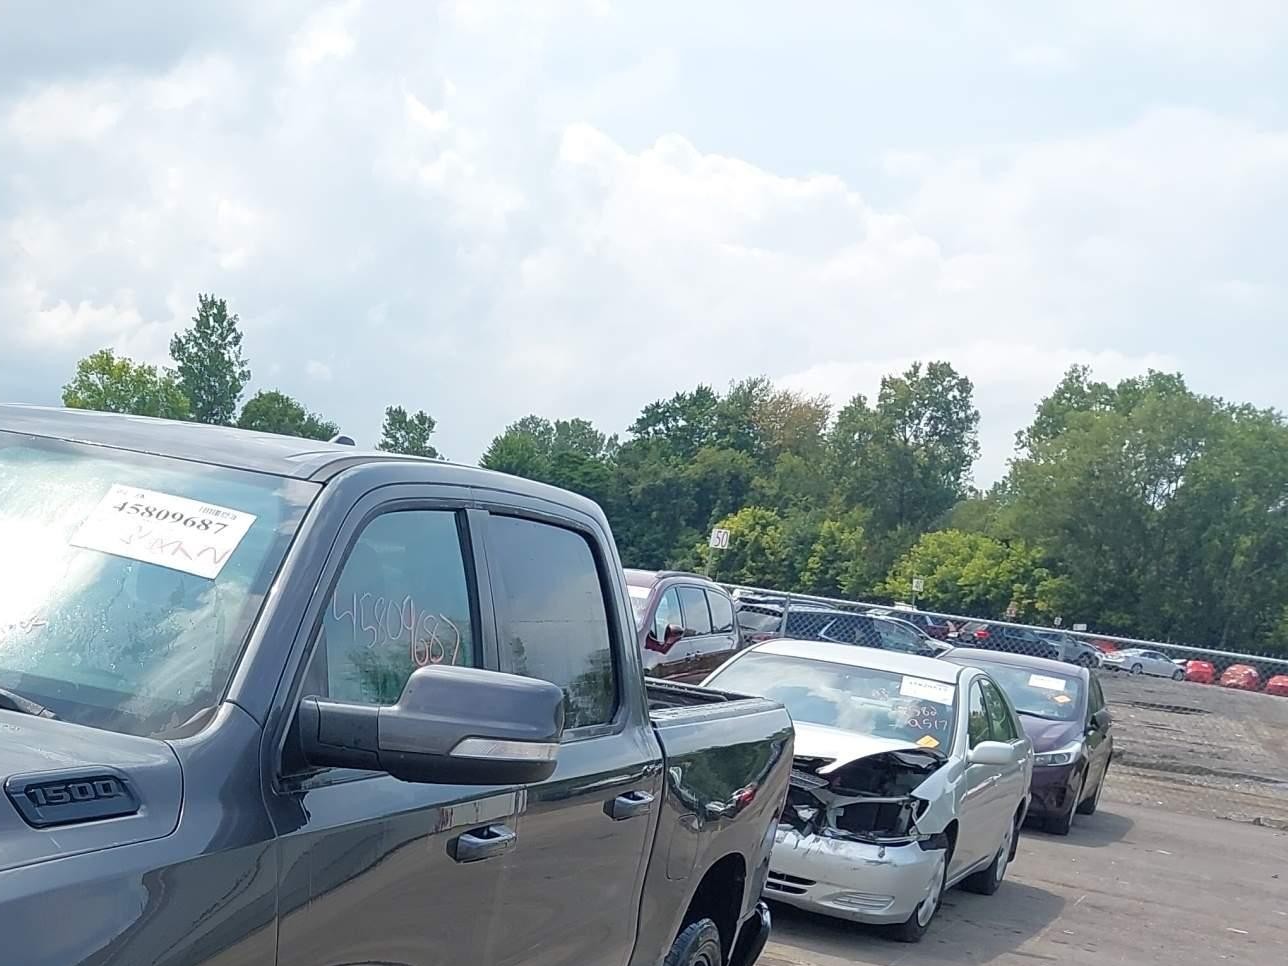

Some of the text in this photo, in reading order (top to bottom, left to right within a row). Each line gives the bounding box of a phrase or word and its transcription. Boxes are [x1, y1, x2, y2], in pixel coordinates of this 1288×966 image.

[112, 500, 230, 535] 45809687
[713, 530, 729, 548] 50
[332, 587, 461, 667] 45809687
[27, 779, 128, 806] 1500
